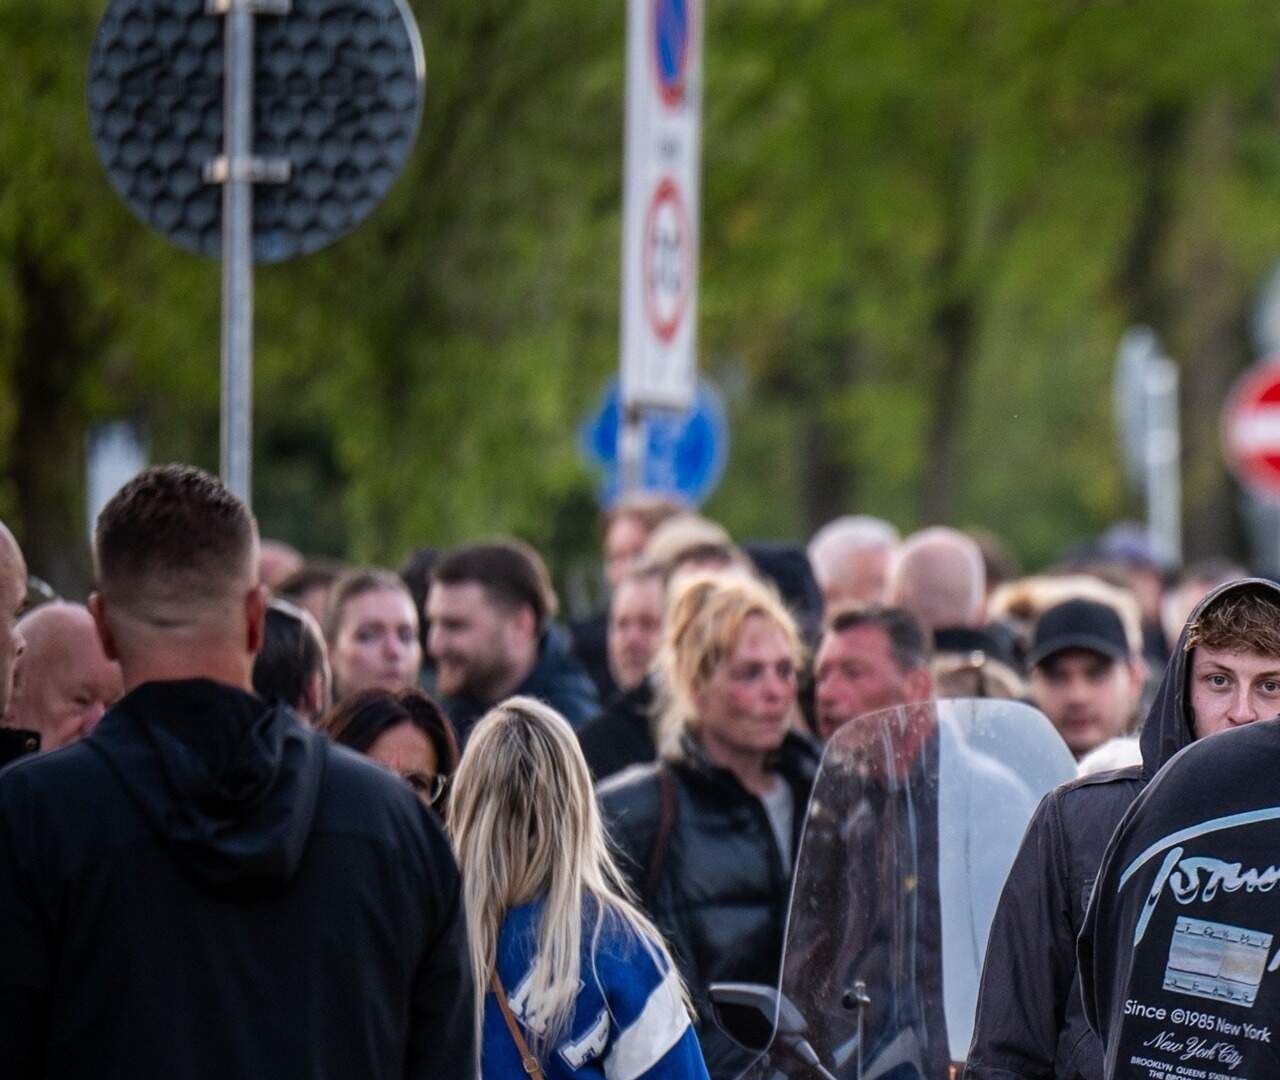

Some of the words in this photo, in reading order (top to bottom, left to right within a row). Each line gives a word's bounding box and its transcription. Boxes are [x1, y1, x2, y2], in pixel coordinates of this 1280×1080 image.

[1123, 999, 1167, 1020] Since
[1215, 1016, 1241, 1036] New
[1242, 1022, 1272, 1043] York
[1143, 1030, 1184, 1053] New
[1179, 1036, 1218, 1061] York
[1217, 1042, 1245, 1070] City
[1130, 1055, 1174, 1072] BROOKLYN
[1175, 1065, 1207, 1080] QUEENS
[1148, 1069, 1164, 1080] THE
